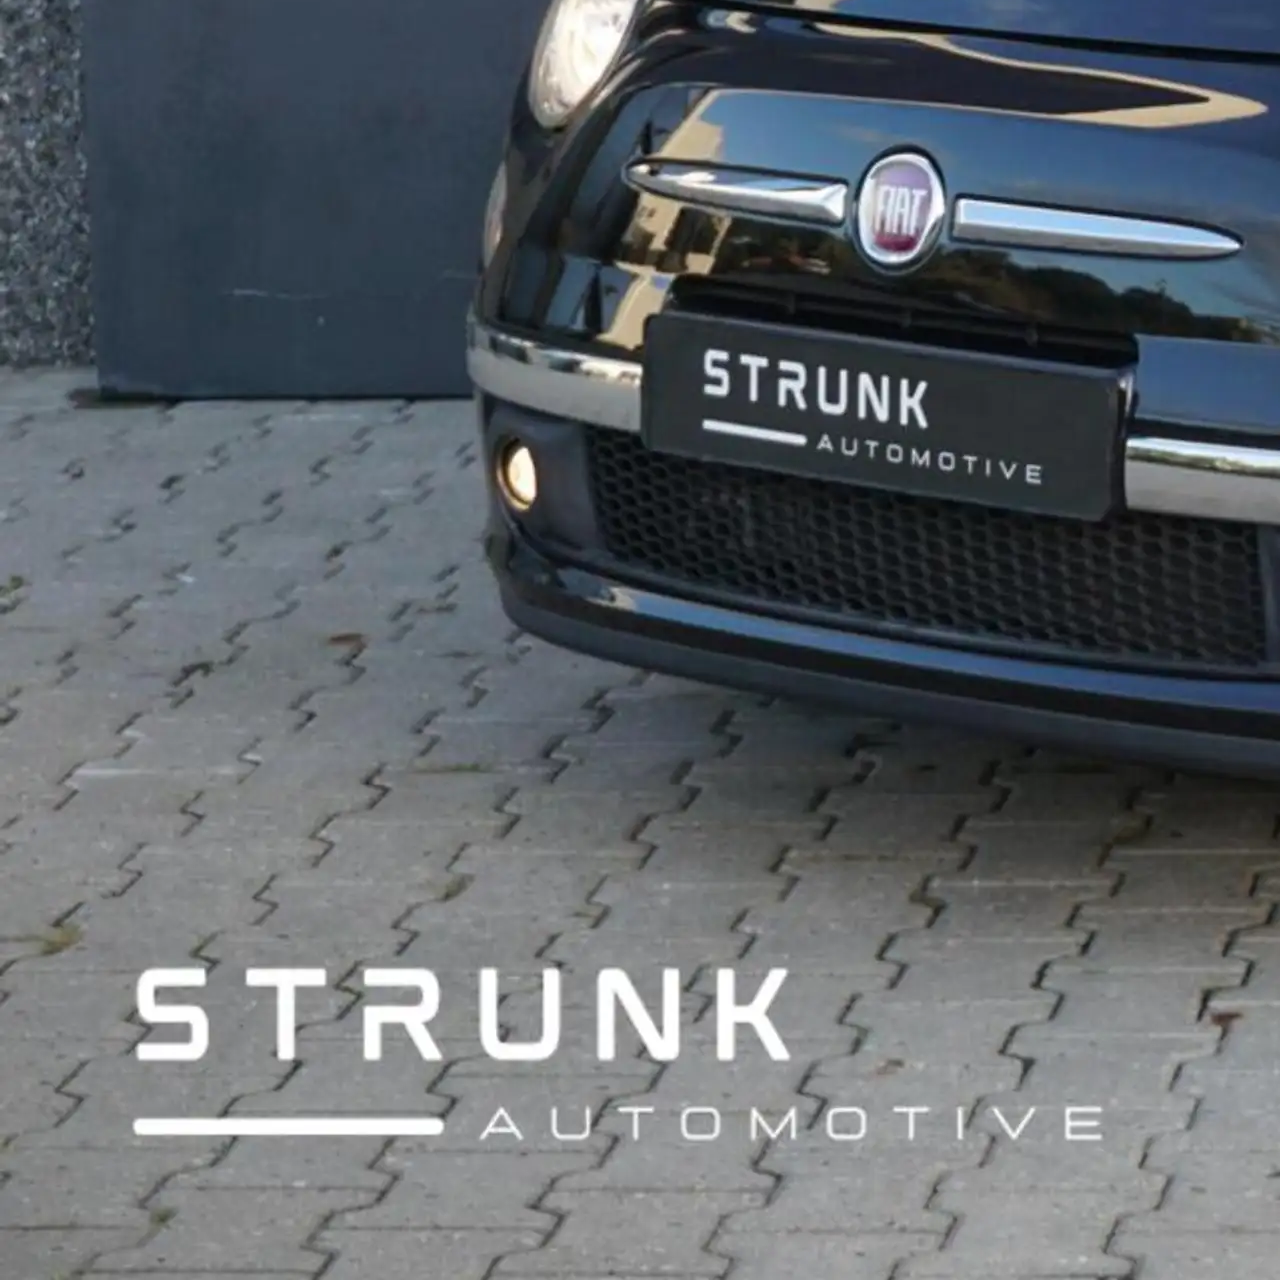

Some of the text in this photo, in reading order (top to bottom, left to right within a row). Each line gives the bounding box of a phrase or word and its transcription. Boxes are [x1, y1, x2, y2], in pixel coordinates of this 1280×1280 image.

[874, 185, 928, 235] FIAT
[703, 349, 928, 430] STRUNK
[817, 434, 1043, 485] AUTOMOTIVE
